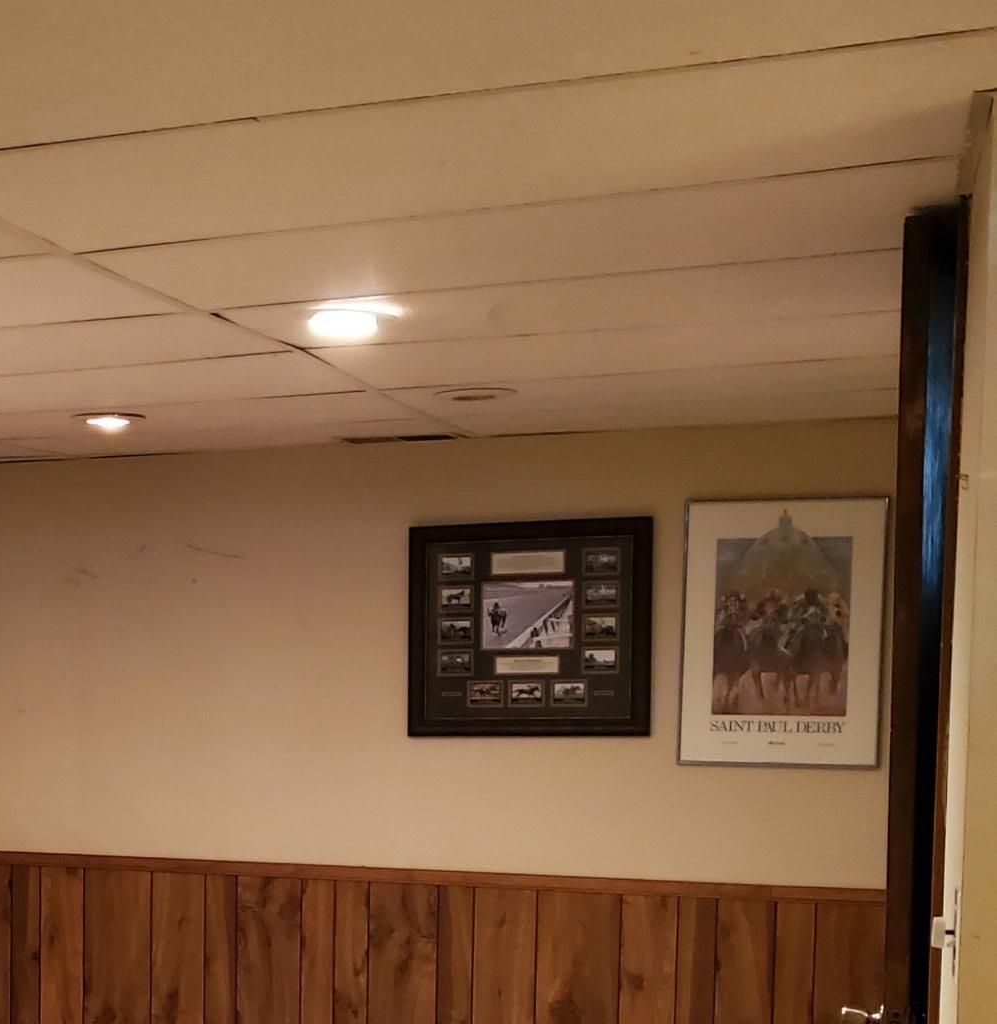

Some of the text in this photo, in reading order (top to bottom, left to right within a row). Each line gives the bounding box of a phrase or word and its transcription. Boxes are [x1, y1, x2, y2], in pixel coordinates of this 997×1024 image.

[709, 720, 846, 734] SAINT PAUL DERBY
